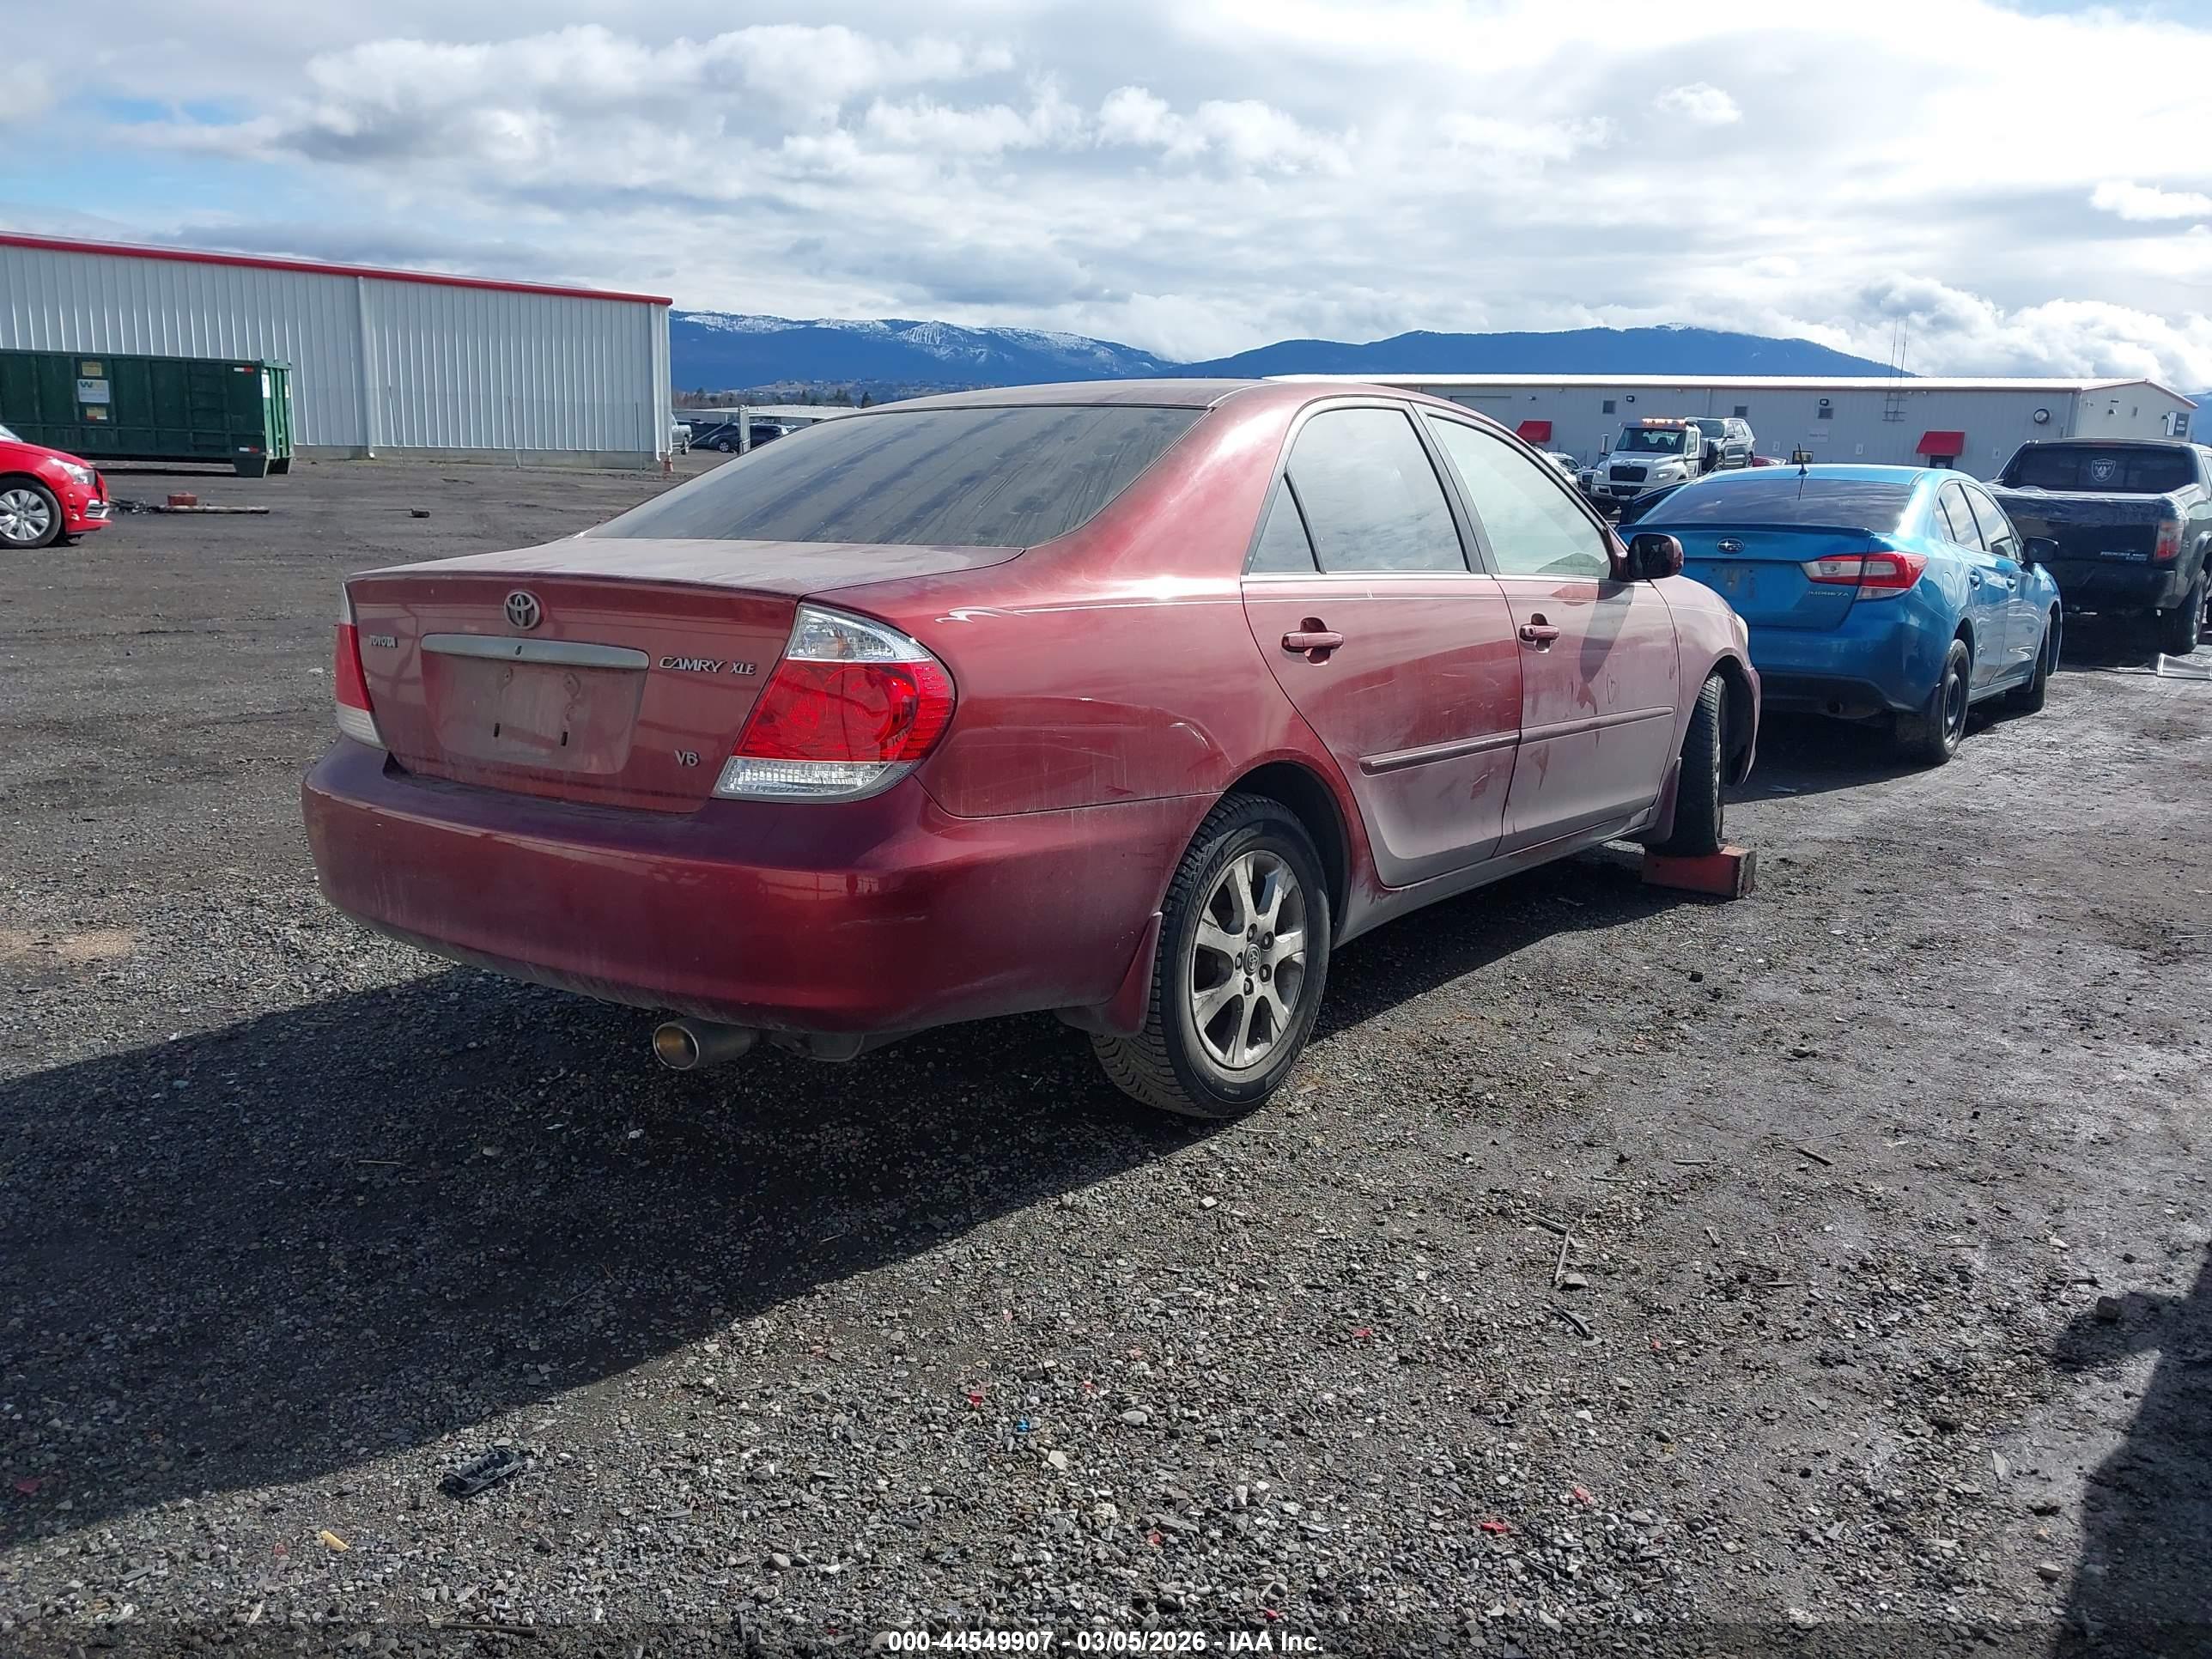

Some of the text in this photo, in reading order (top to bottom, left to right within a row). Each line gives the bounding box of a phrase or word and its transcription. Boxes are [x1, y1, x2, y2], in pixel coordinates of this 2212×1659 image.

[369, 635, 398, 648] TOYOTA
[659, 656, 757, 676] CAMRY XLE
[674, 749, 700, 768] V6
